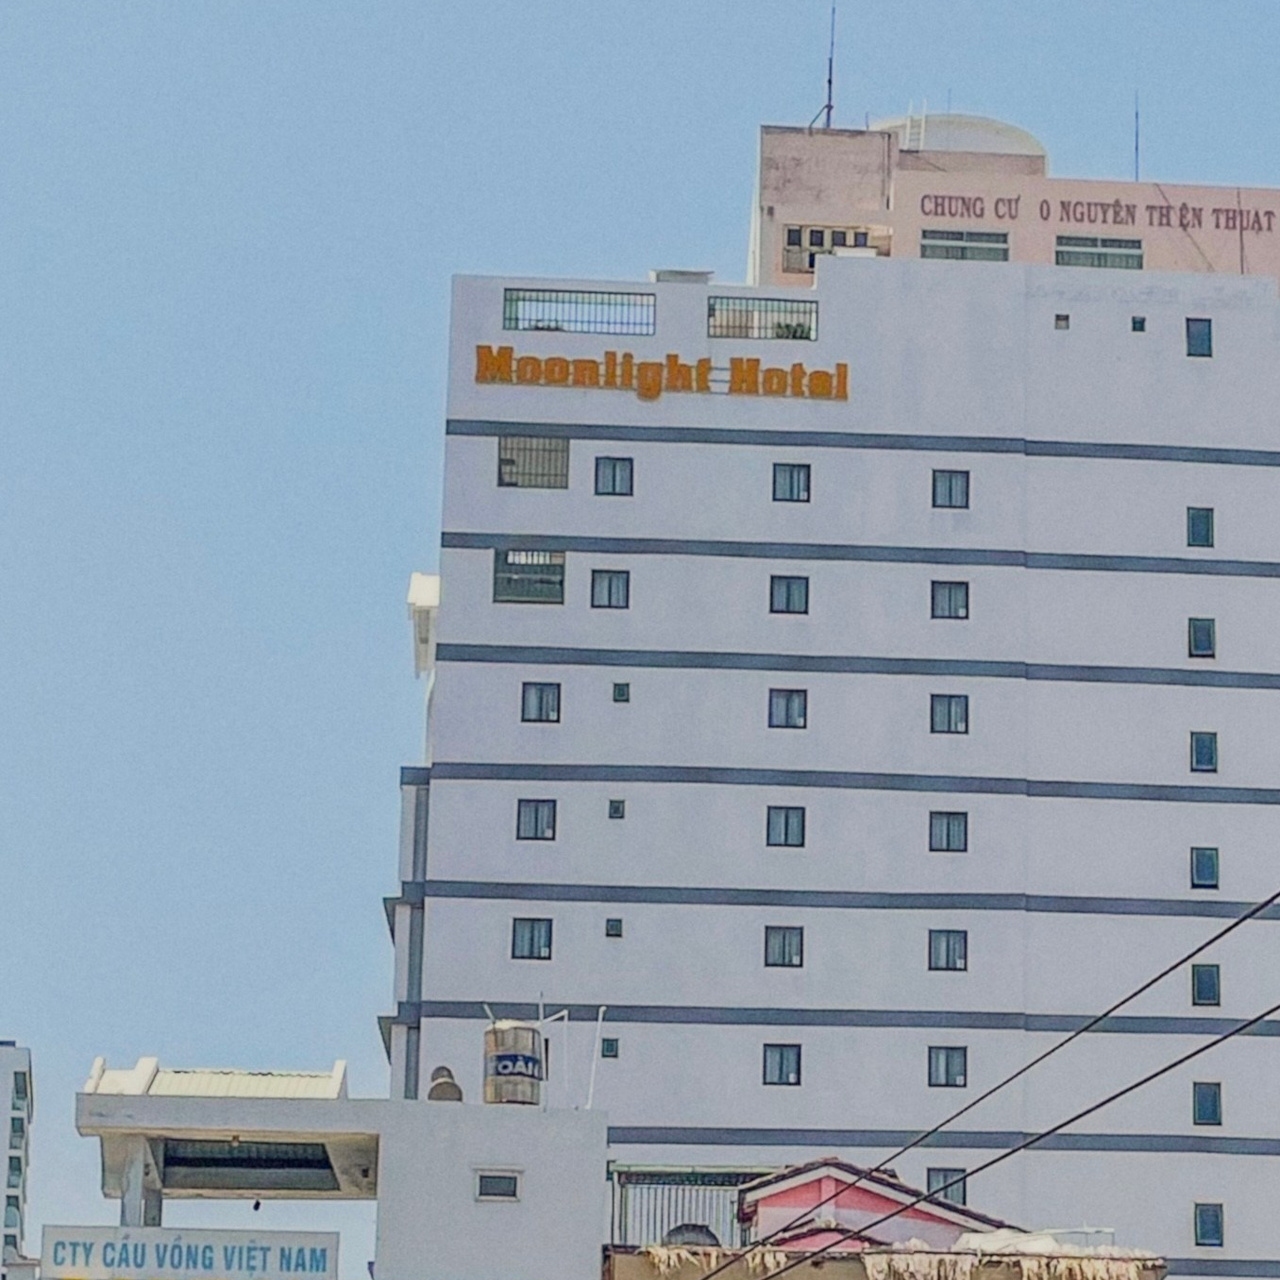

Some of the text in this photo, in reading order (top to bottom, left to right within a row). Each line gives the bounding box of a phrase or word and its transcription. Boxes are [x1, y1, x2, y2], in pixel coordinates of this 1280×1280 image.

[920, 194, 985, 218] CHUNG
[994, 194, 1021, 220] CƯ
[474, 344, 849, 402] Moonlight Hotel
[52, 1240, 95, 1267] CTY
[279, 1246, 328, 1273] NAM
